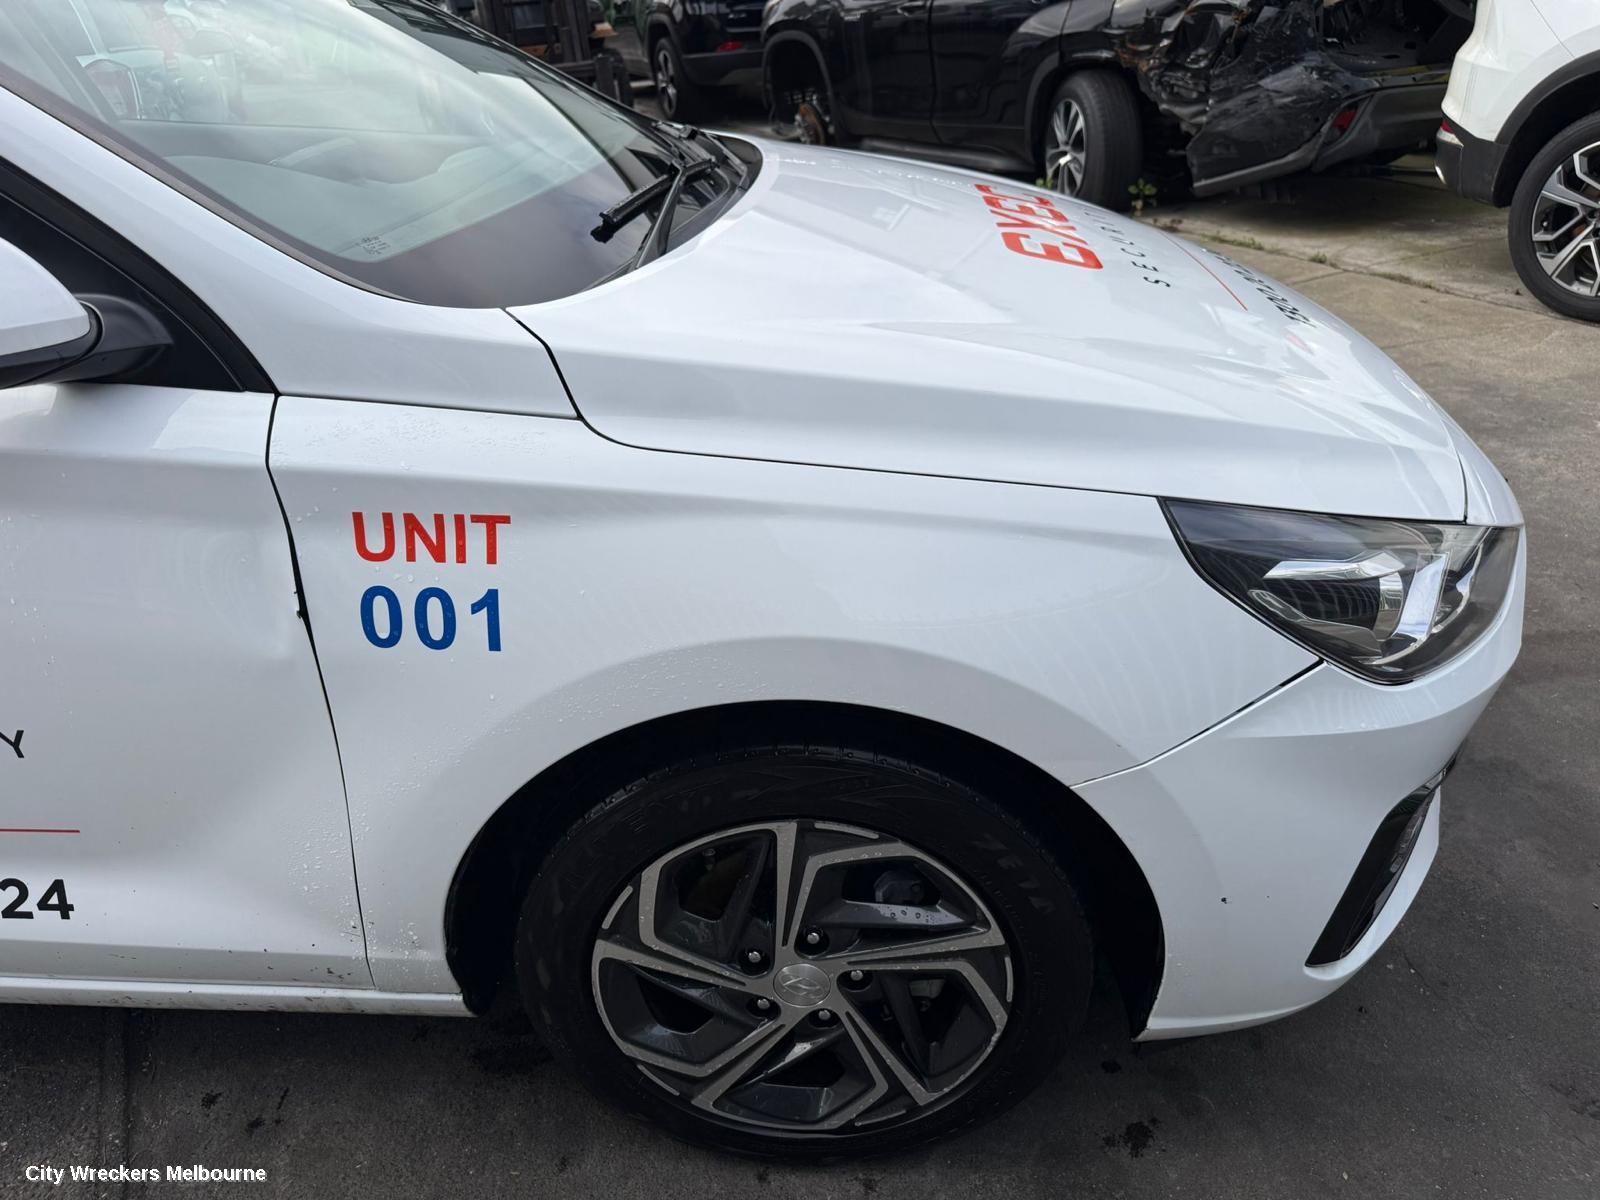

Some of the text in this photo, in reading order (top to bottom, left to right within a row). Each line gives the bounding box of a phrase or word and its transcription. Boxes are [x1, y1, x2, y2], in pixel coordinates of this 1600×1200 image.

[973, 183, 1104, 270] EXEC
[352, 511, 511, 565] UNIT
[360, 585, 502, 652] 001
[0, 877, 75, 920] 24
